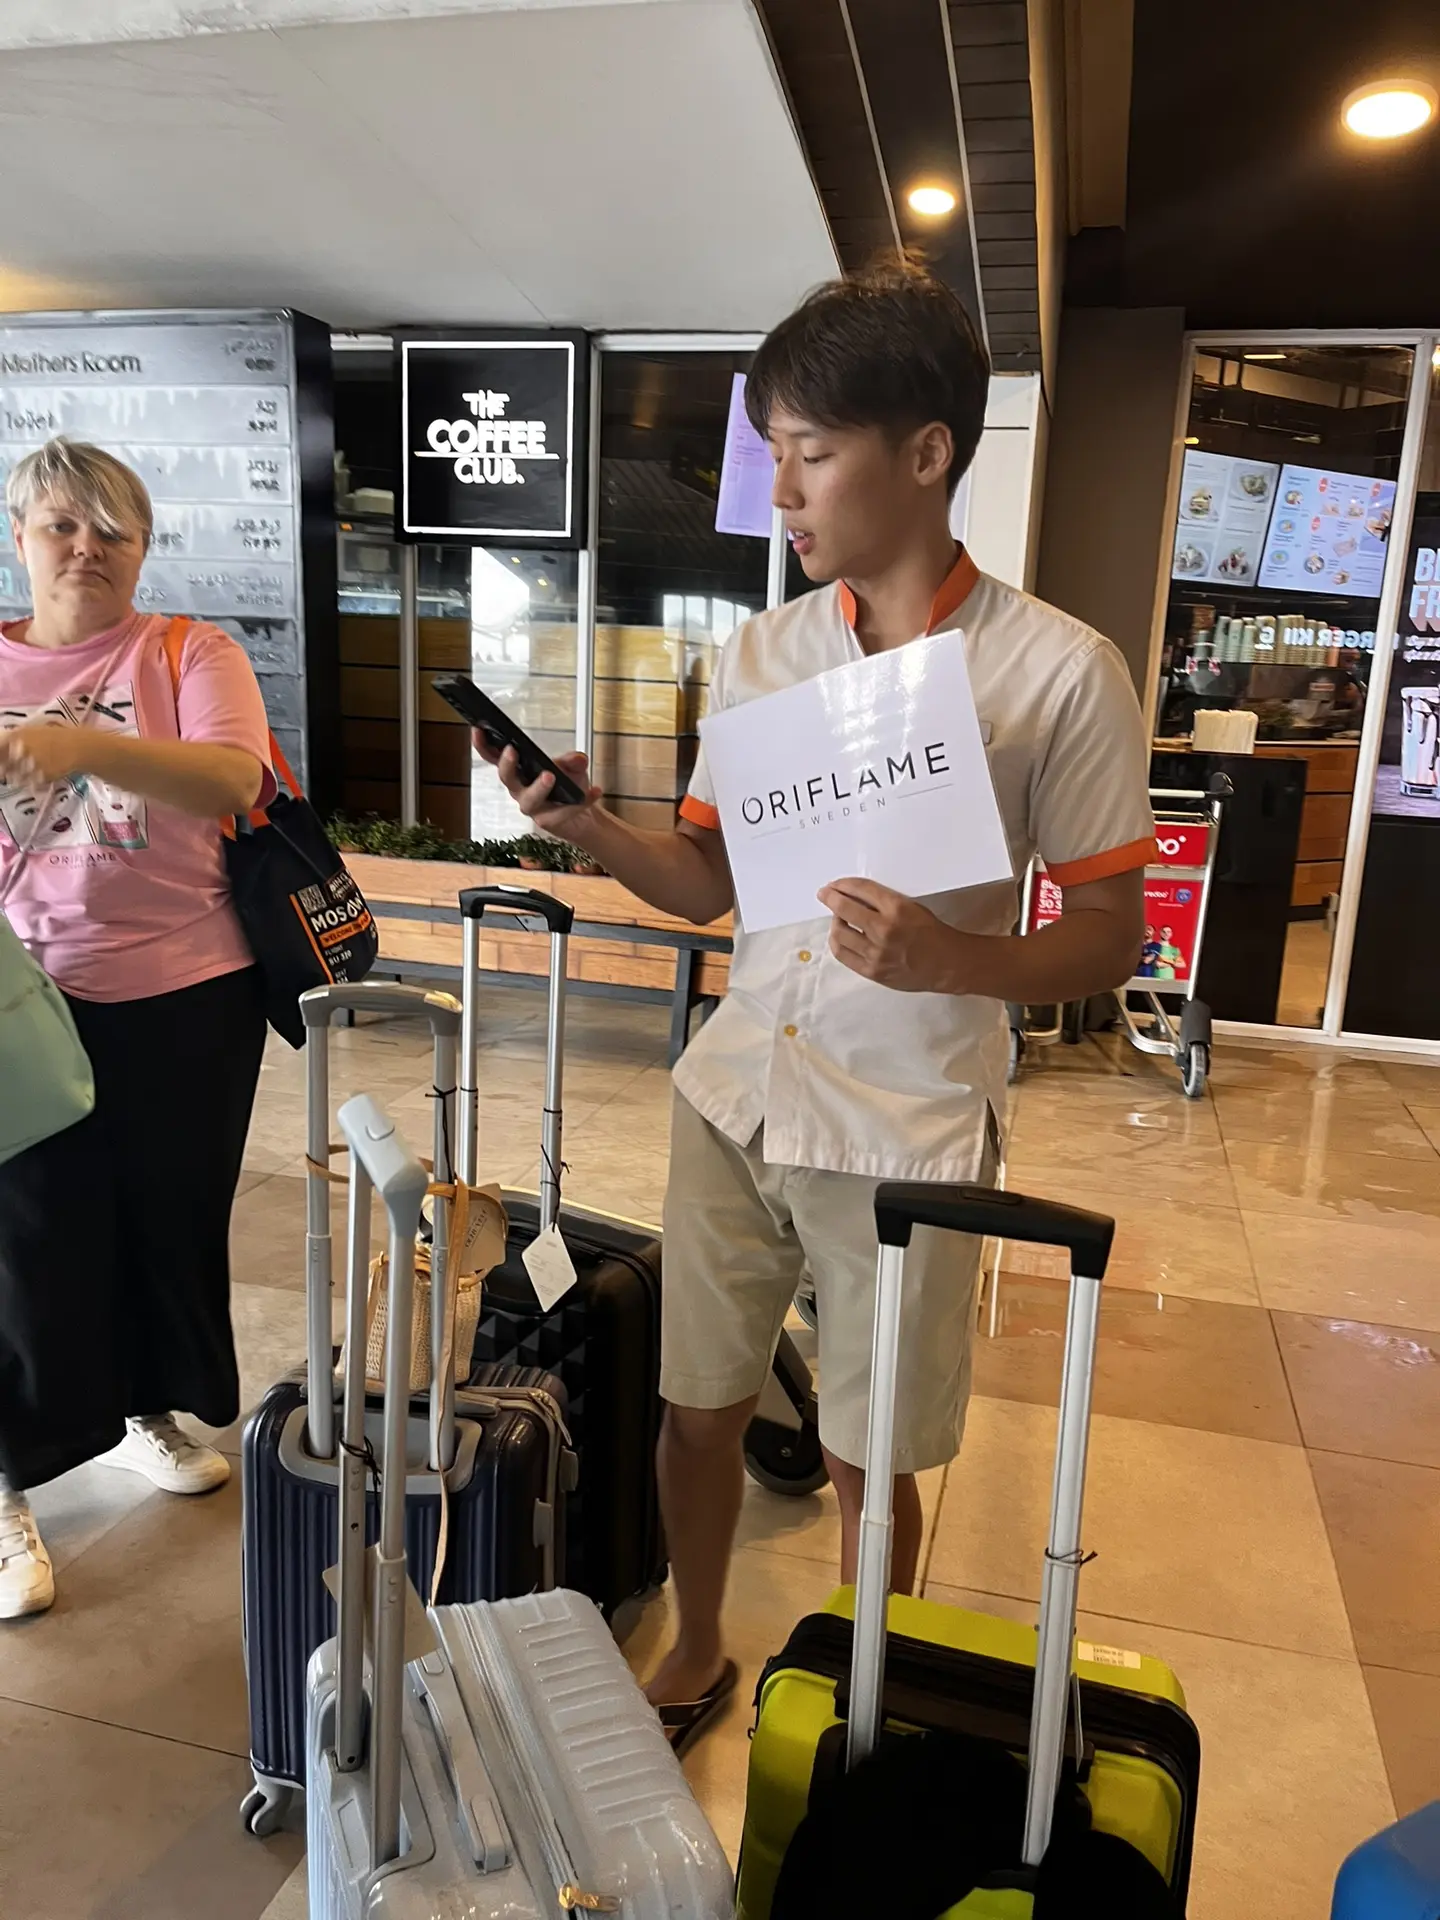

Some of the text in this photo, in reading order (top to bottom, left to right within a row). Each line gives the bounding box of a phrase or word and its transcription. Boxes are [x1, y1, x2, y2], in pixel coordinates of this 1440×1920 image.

[82, 351, 142, 373] Room
[462, 389, 510, 419] THE
[427, 418, 546, 454] COFFEE
[742, 742, 950, 825] ORIFLAME
[798, 797, 887, 829] SWEDEN
